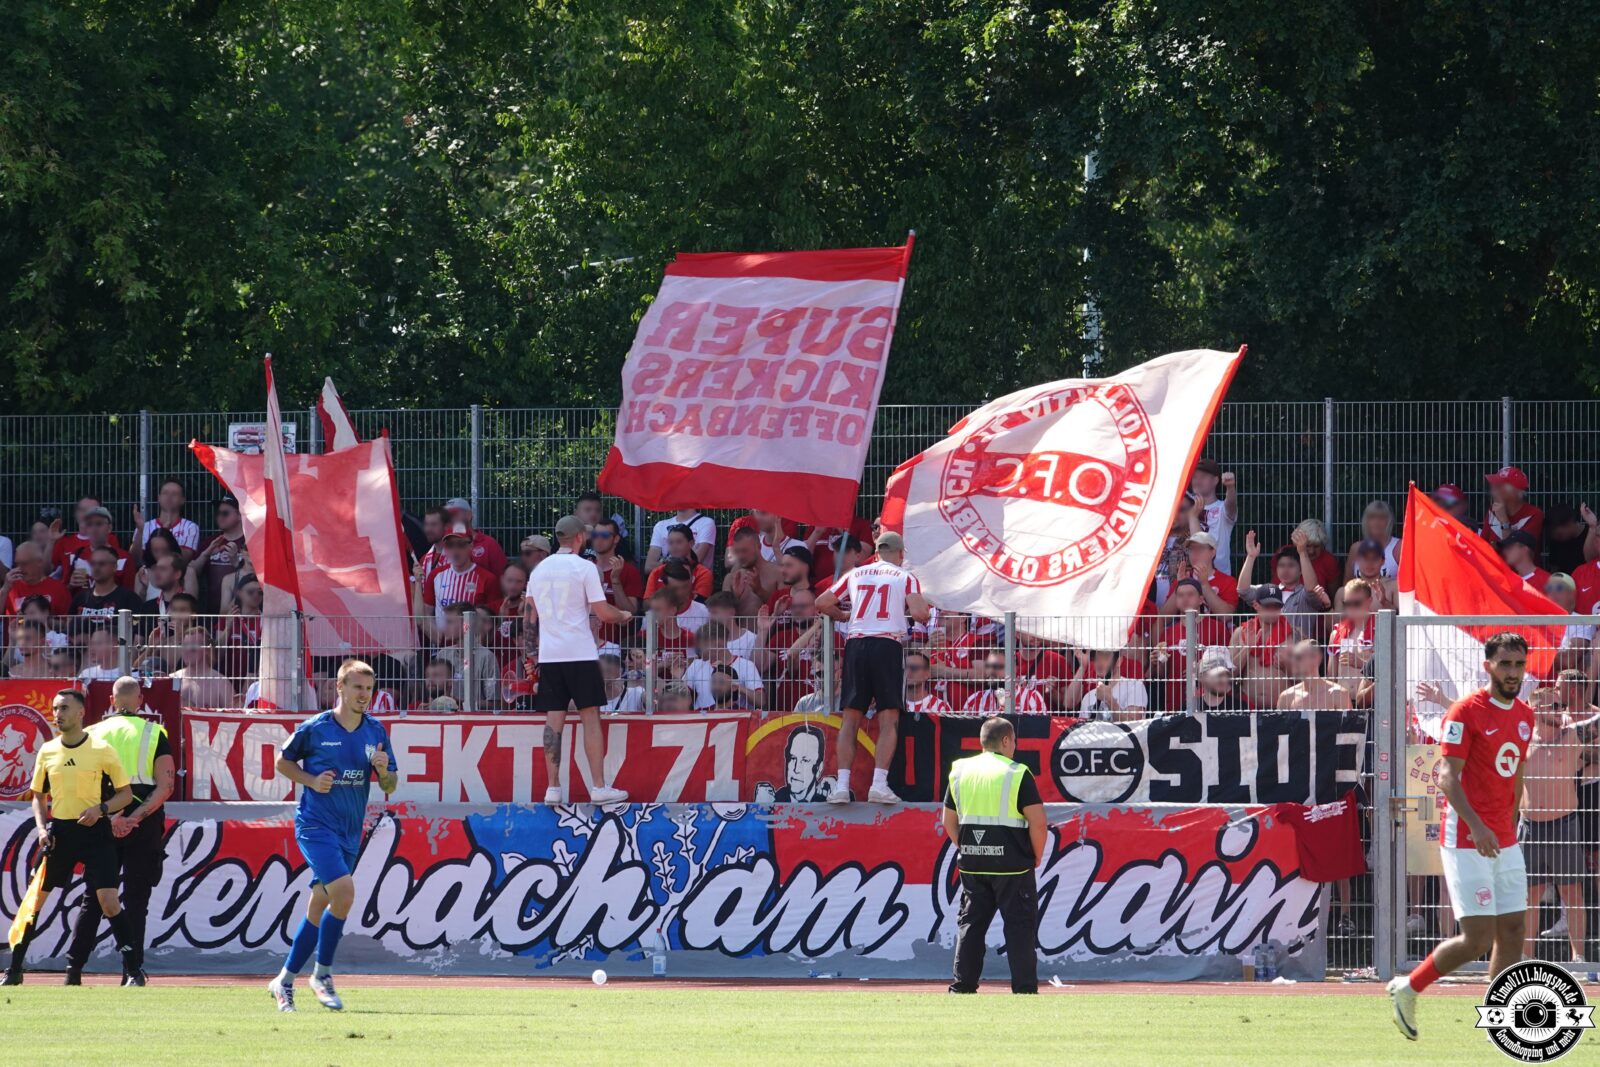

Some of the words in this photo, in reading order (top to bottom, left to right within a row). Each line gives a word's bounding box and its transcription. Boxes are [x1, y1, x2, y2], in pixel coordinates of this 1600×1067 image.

[856, 583, 890, 621] 71
[190, 719, 629, 801] KOEKTIV
[652, 720, 739, 802] 71
[1060, 748, 1137, 775] O.F.C.
[1147, 711, 1368, 802] SIDE
[0, 811, 660, 957] Ofenbach
[679, 852, 909, 957] am
